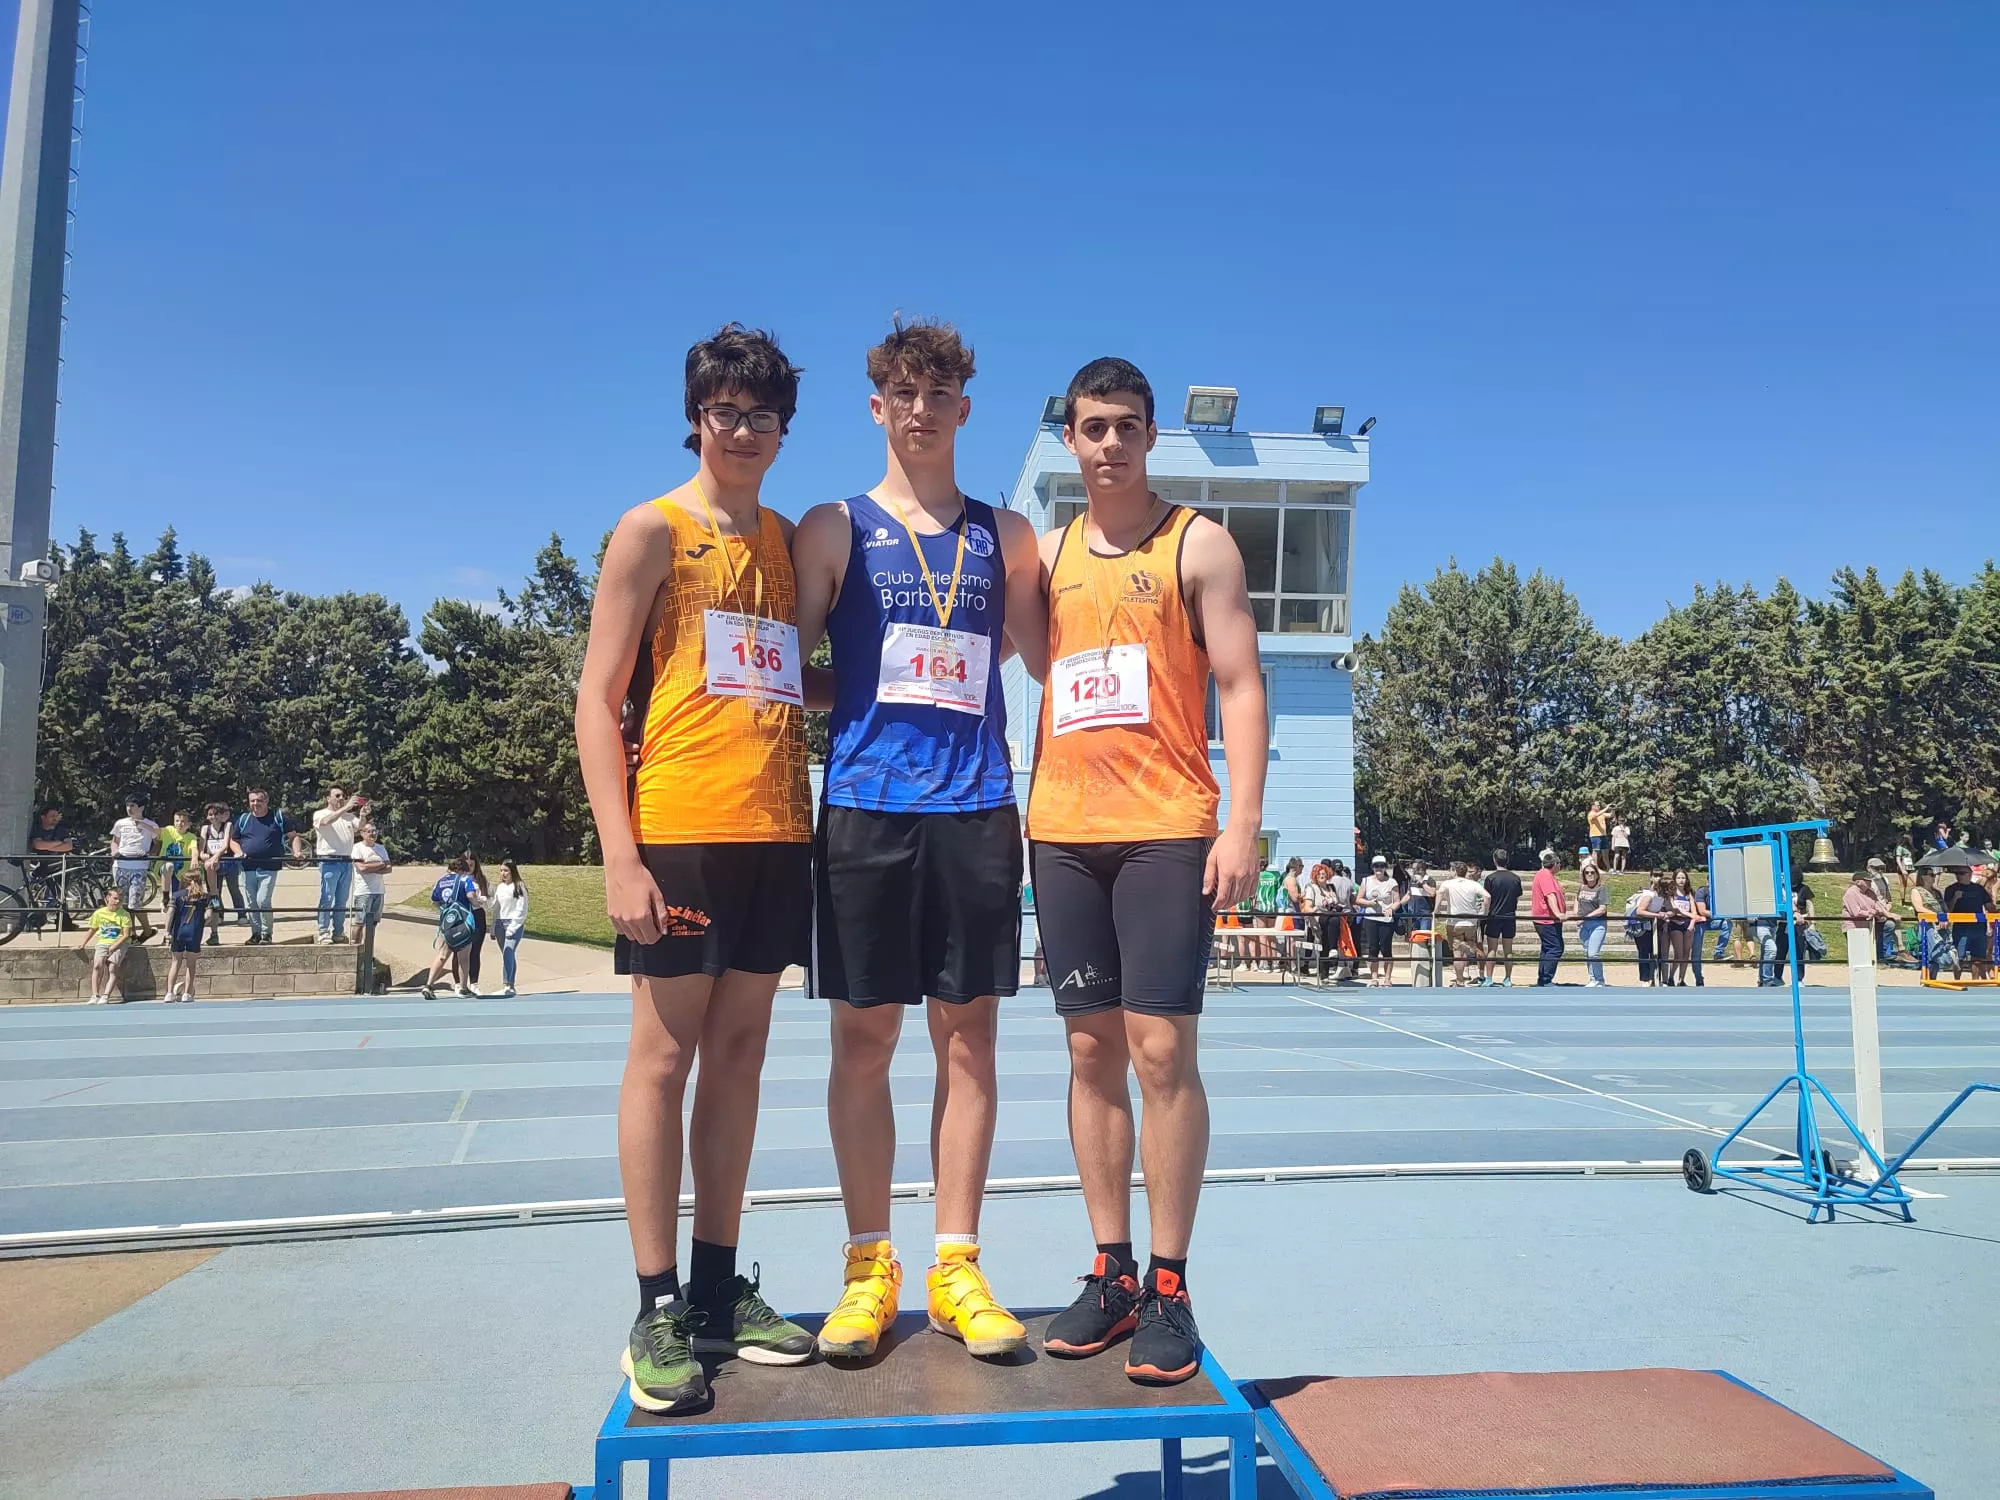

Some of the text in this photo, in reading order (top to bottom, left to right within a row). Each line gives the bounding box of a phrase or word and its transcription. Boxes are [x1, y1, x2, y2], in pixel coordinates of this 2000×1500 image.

[866, 538, 899, 548] VIATOR
[873, 570, 914, 587] Club
[881, 586, 986, 611] Barbastro
[732, 642, 783, 672] 136
[910, 653, 968, 683] 164
[1070, 674, 1120, 703] 120
